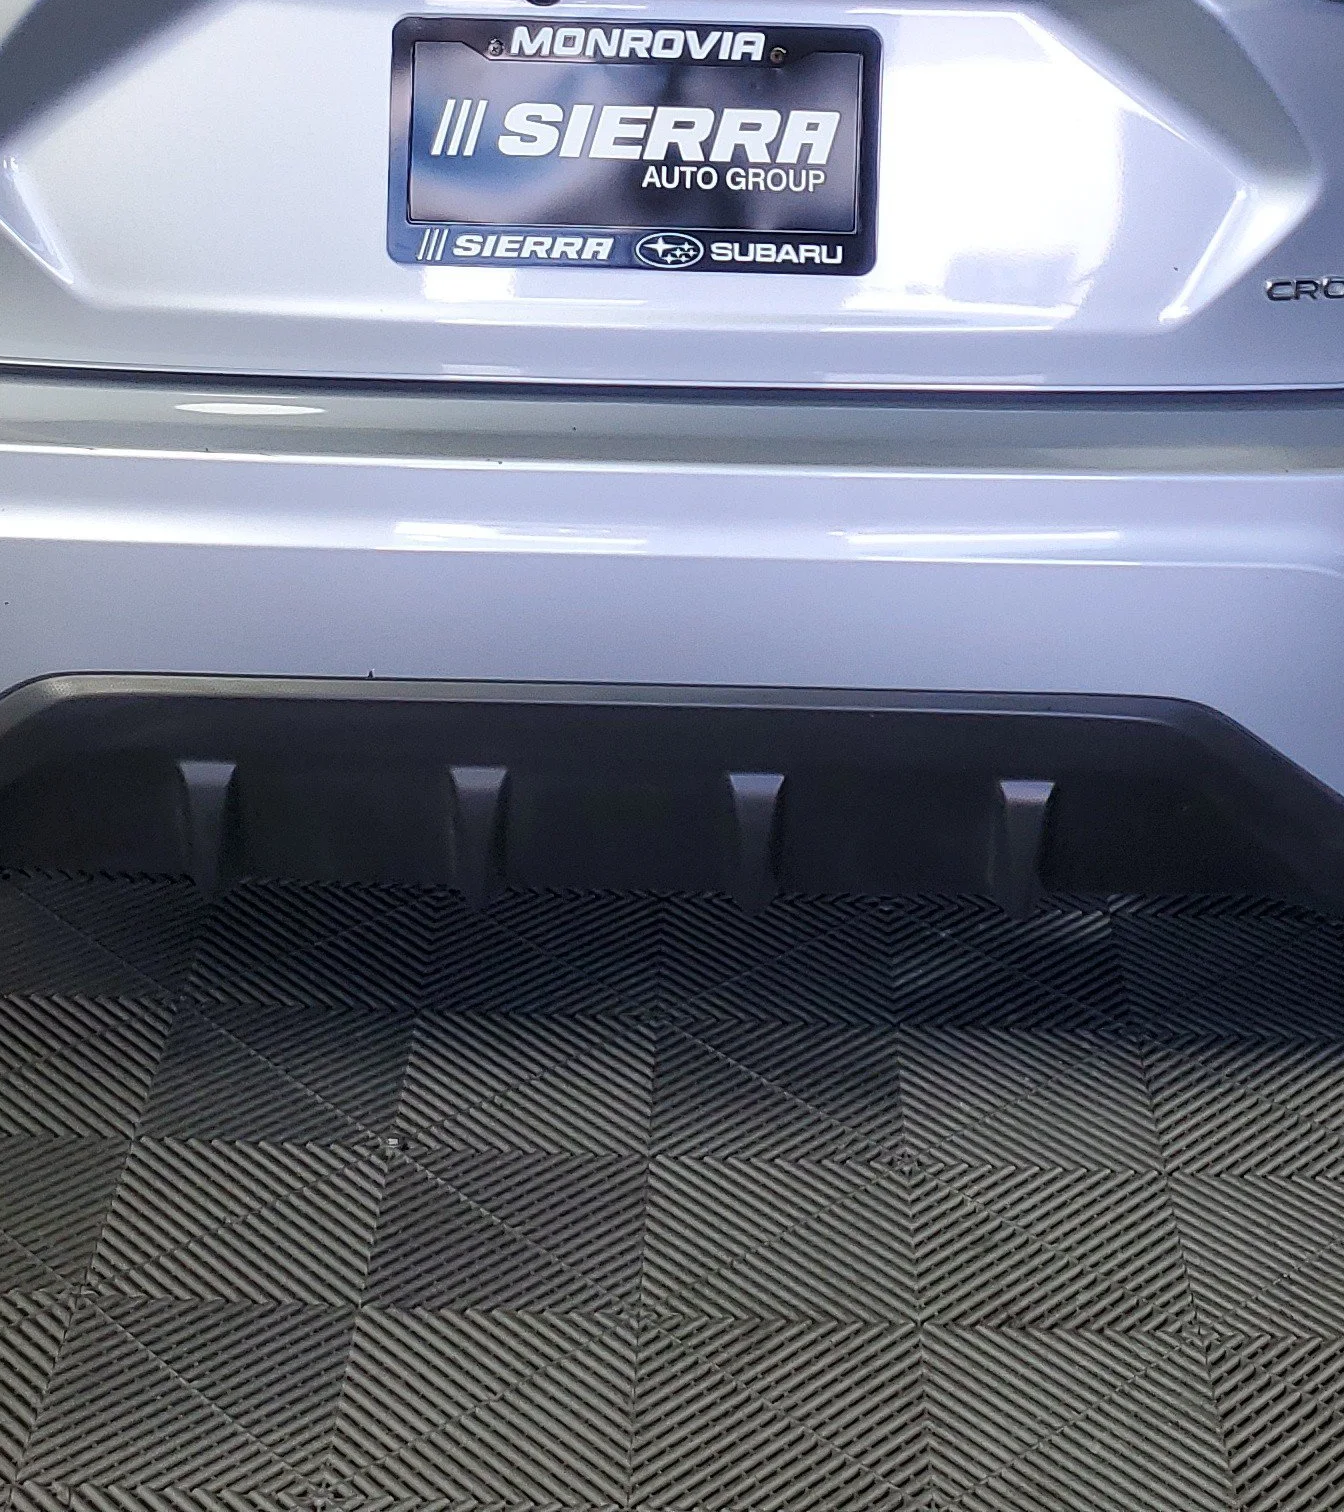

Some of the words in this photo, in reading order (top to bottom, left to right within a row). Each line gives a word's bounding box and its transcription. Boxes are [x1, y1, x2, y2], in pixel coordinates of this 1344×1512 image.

[510, 26, 766, 61] MONROVIA
[498, 103, 841, 164] SIERRA
[641, 165, 718, 190] AUTO
[726, 168, 825, 192] GROUP
[453, 235, 614, 259] SIERRA
[710, 243, 843, 264] SUBARU
